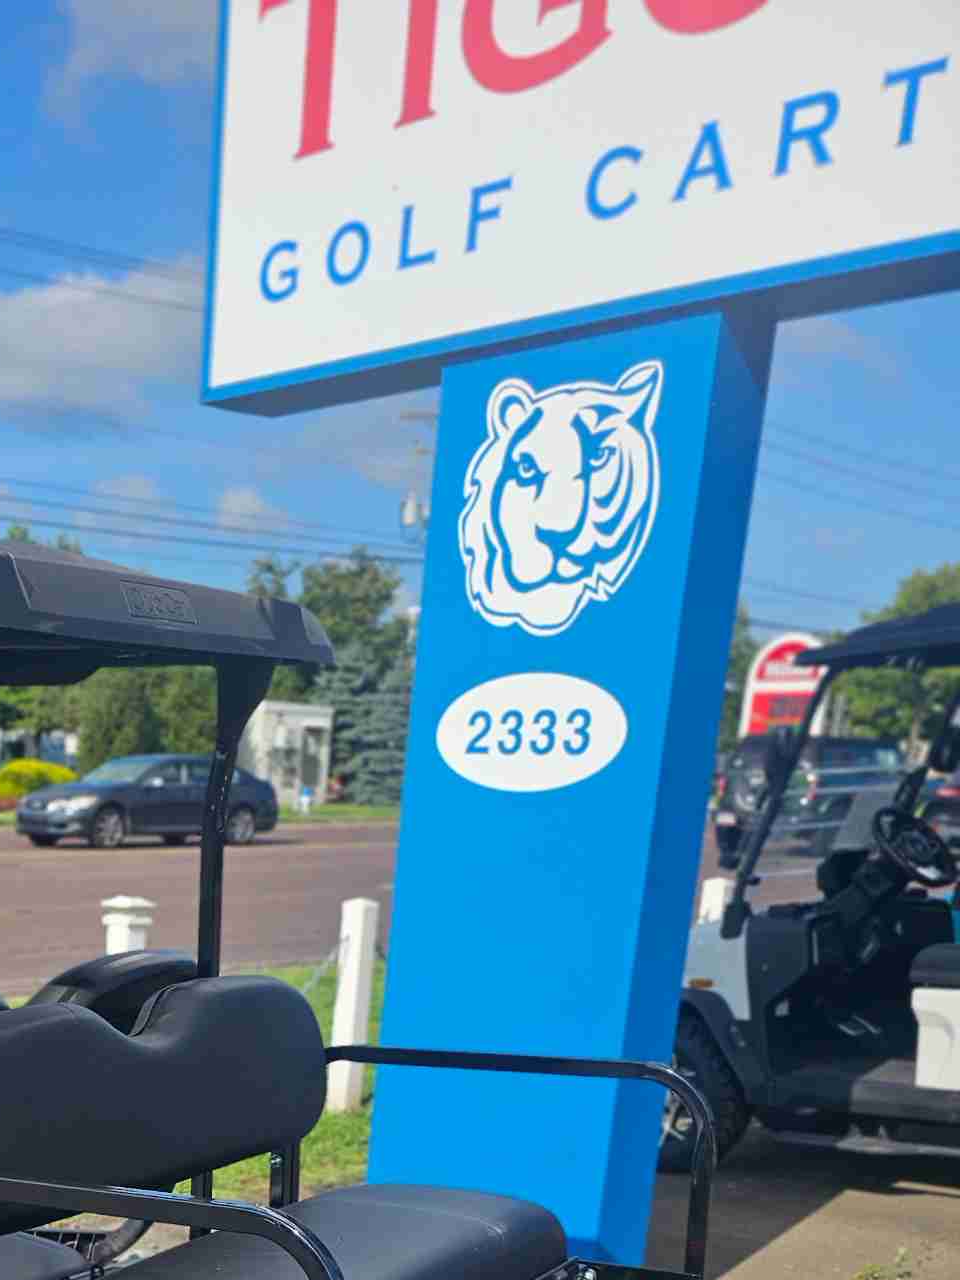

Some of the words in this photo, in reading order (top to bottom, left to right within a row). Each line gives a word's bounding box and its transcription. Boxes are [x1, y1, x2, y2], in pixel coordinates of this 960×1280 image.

[258, 0, 771, 160] TIG
[259, 175, 515, 304] GOLF
[465, 709, 592, 755] 2333
